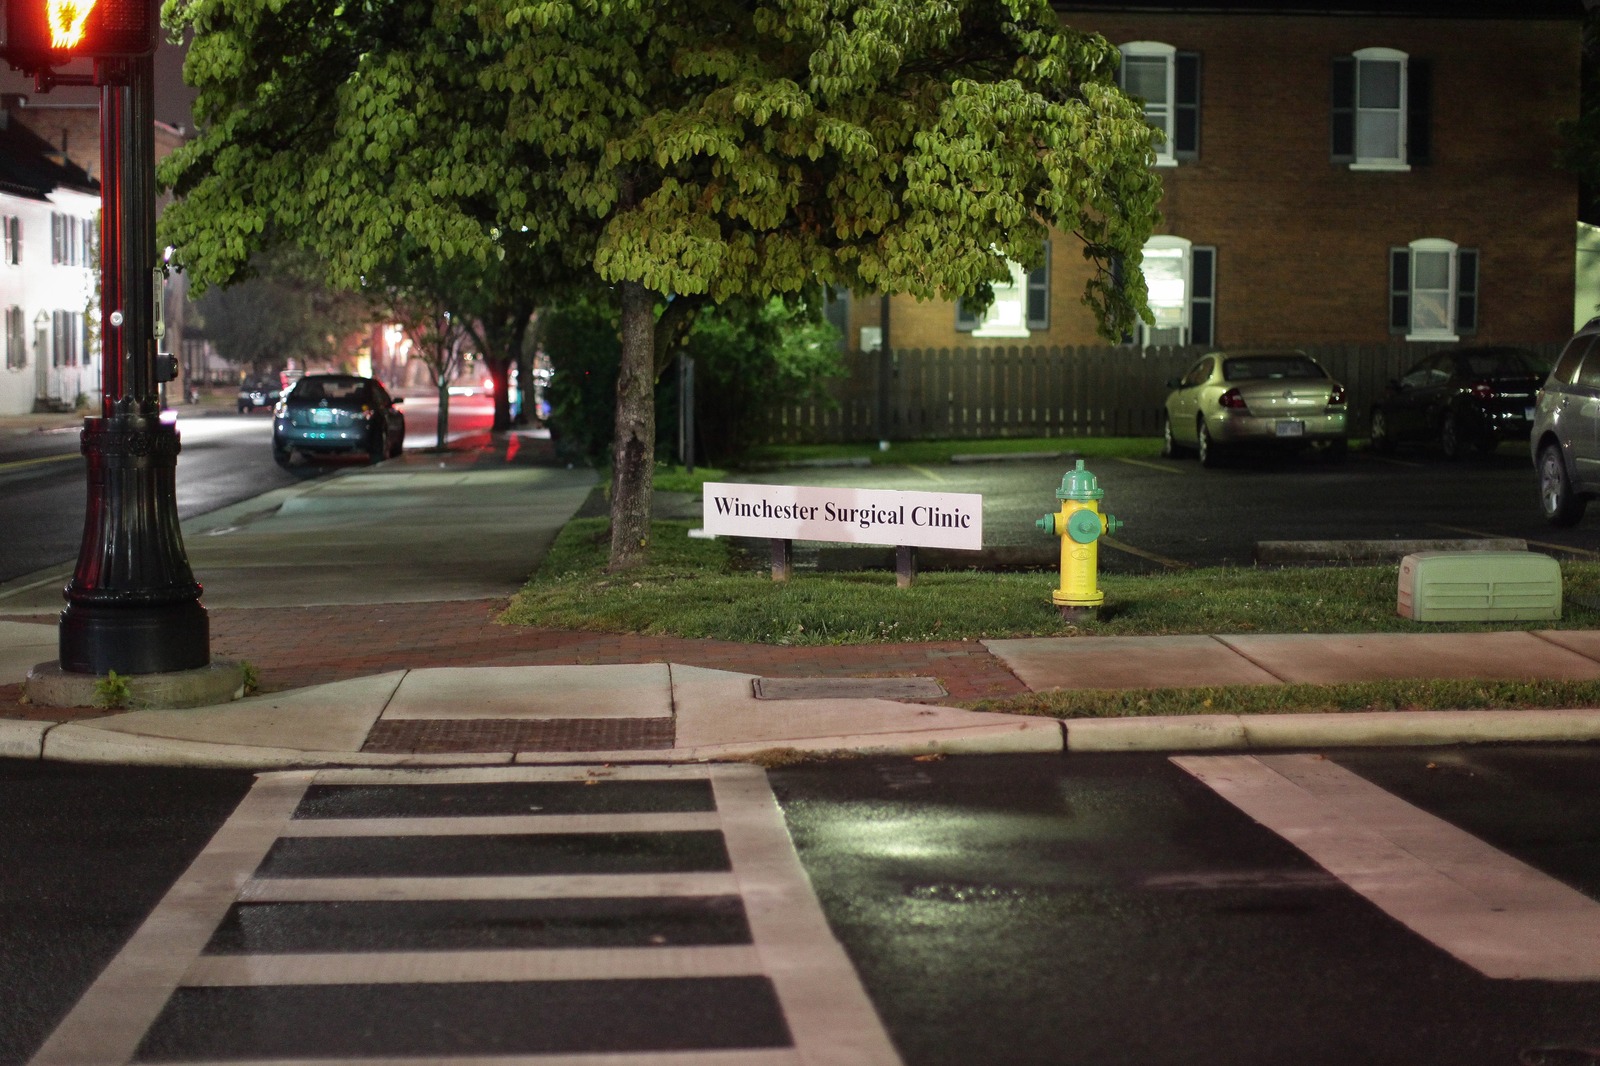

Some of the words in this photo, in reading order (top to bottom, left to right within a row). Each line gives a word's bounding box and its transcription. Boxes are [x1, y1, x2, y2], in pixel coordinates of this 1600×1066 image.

[714, 496, 819, 521] Winchester
[824, 501, 905, 529] Surgical
[911, 505, 971, 529] Clinic
